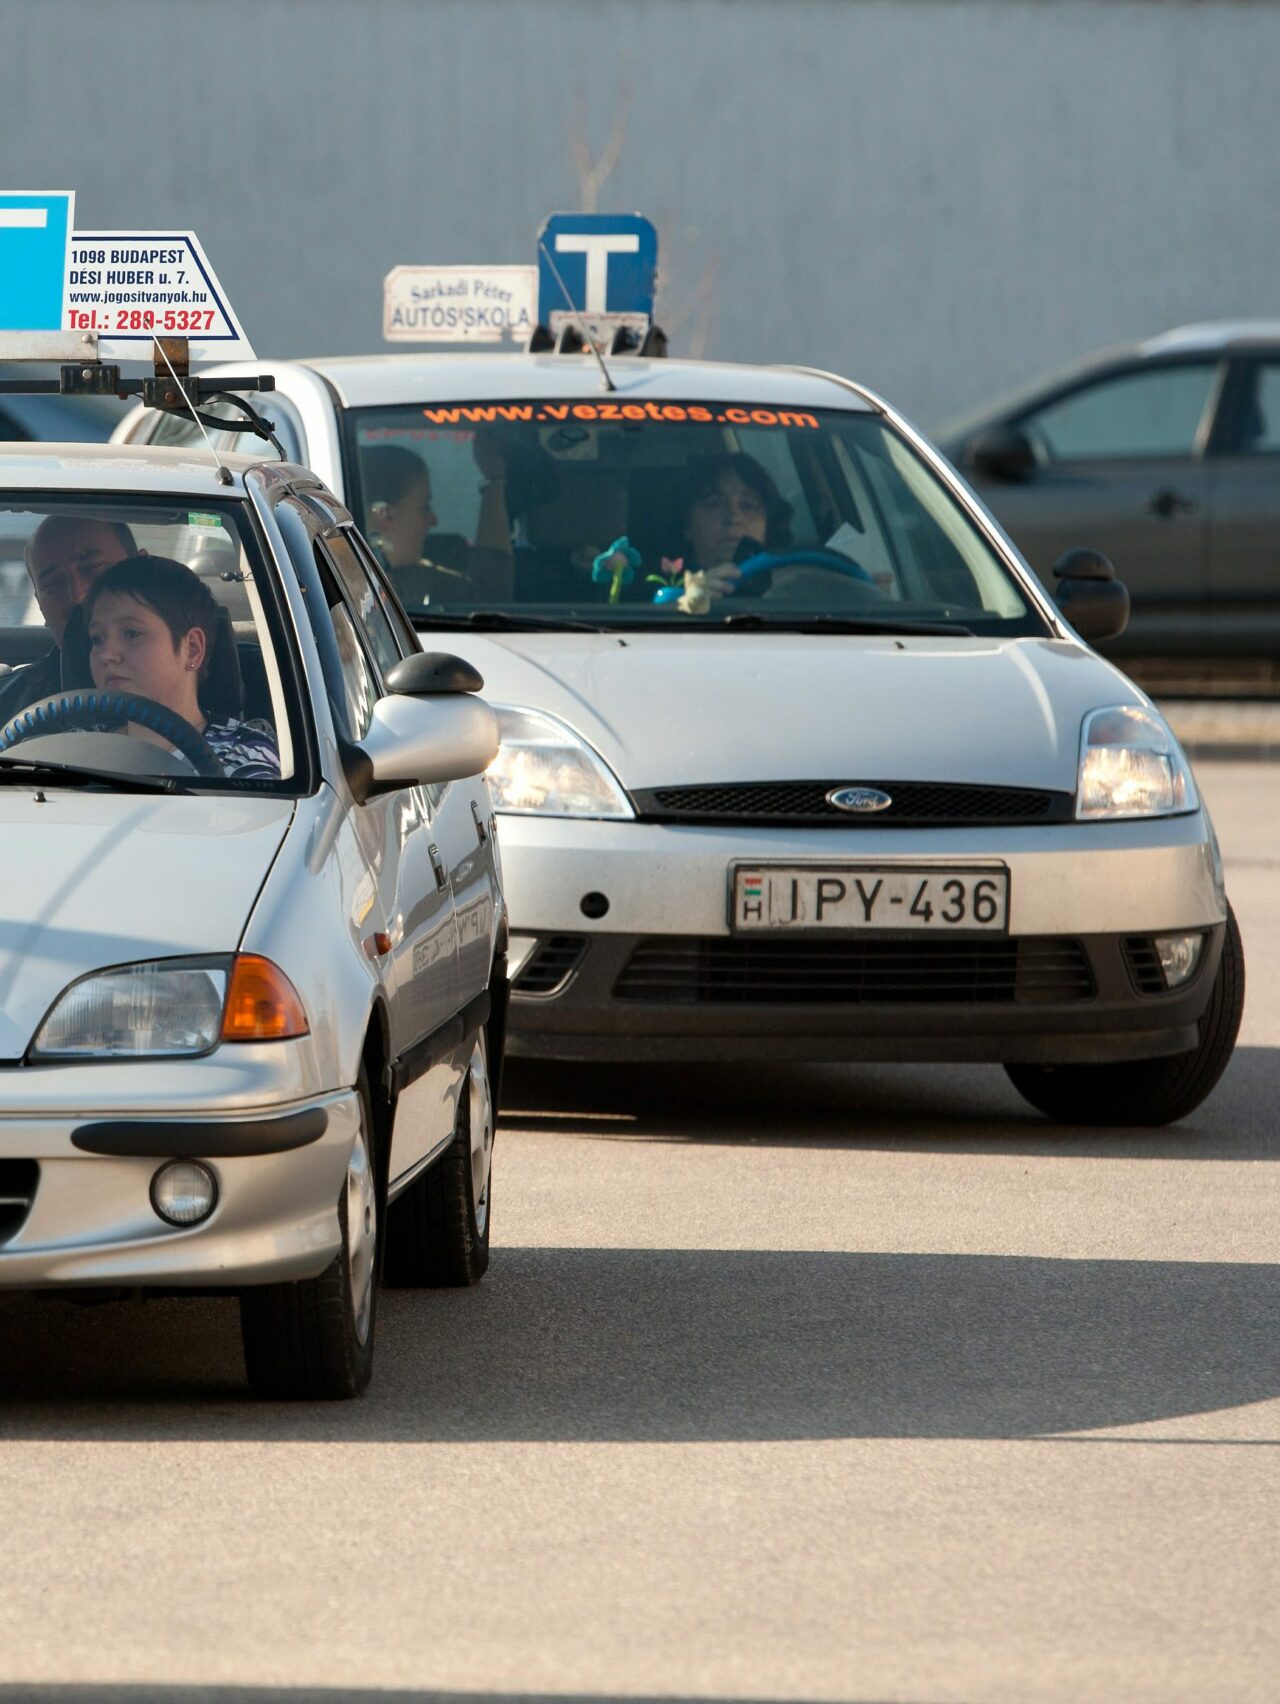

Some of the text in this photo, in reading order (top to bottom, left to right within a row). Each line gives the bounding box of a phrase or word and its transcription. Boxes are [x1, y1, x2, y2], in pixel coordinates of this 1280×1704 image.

[71, 249, 185, 264] 1098 BUDAPEST
[69, 267, 190, 285] DÉSI HUBER u. 7.
[555, 233, 640, 313] T
[69, 290, 208, 305] www.jogositvanyok.hu
[68, 309, 110, 330] Tel.:
[422, 401, 820, 429] www.vezetes.com
[742, 878, 999, 923] H IPY-436
